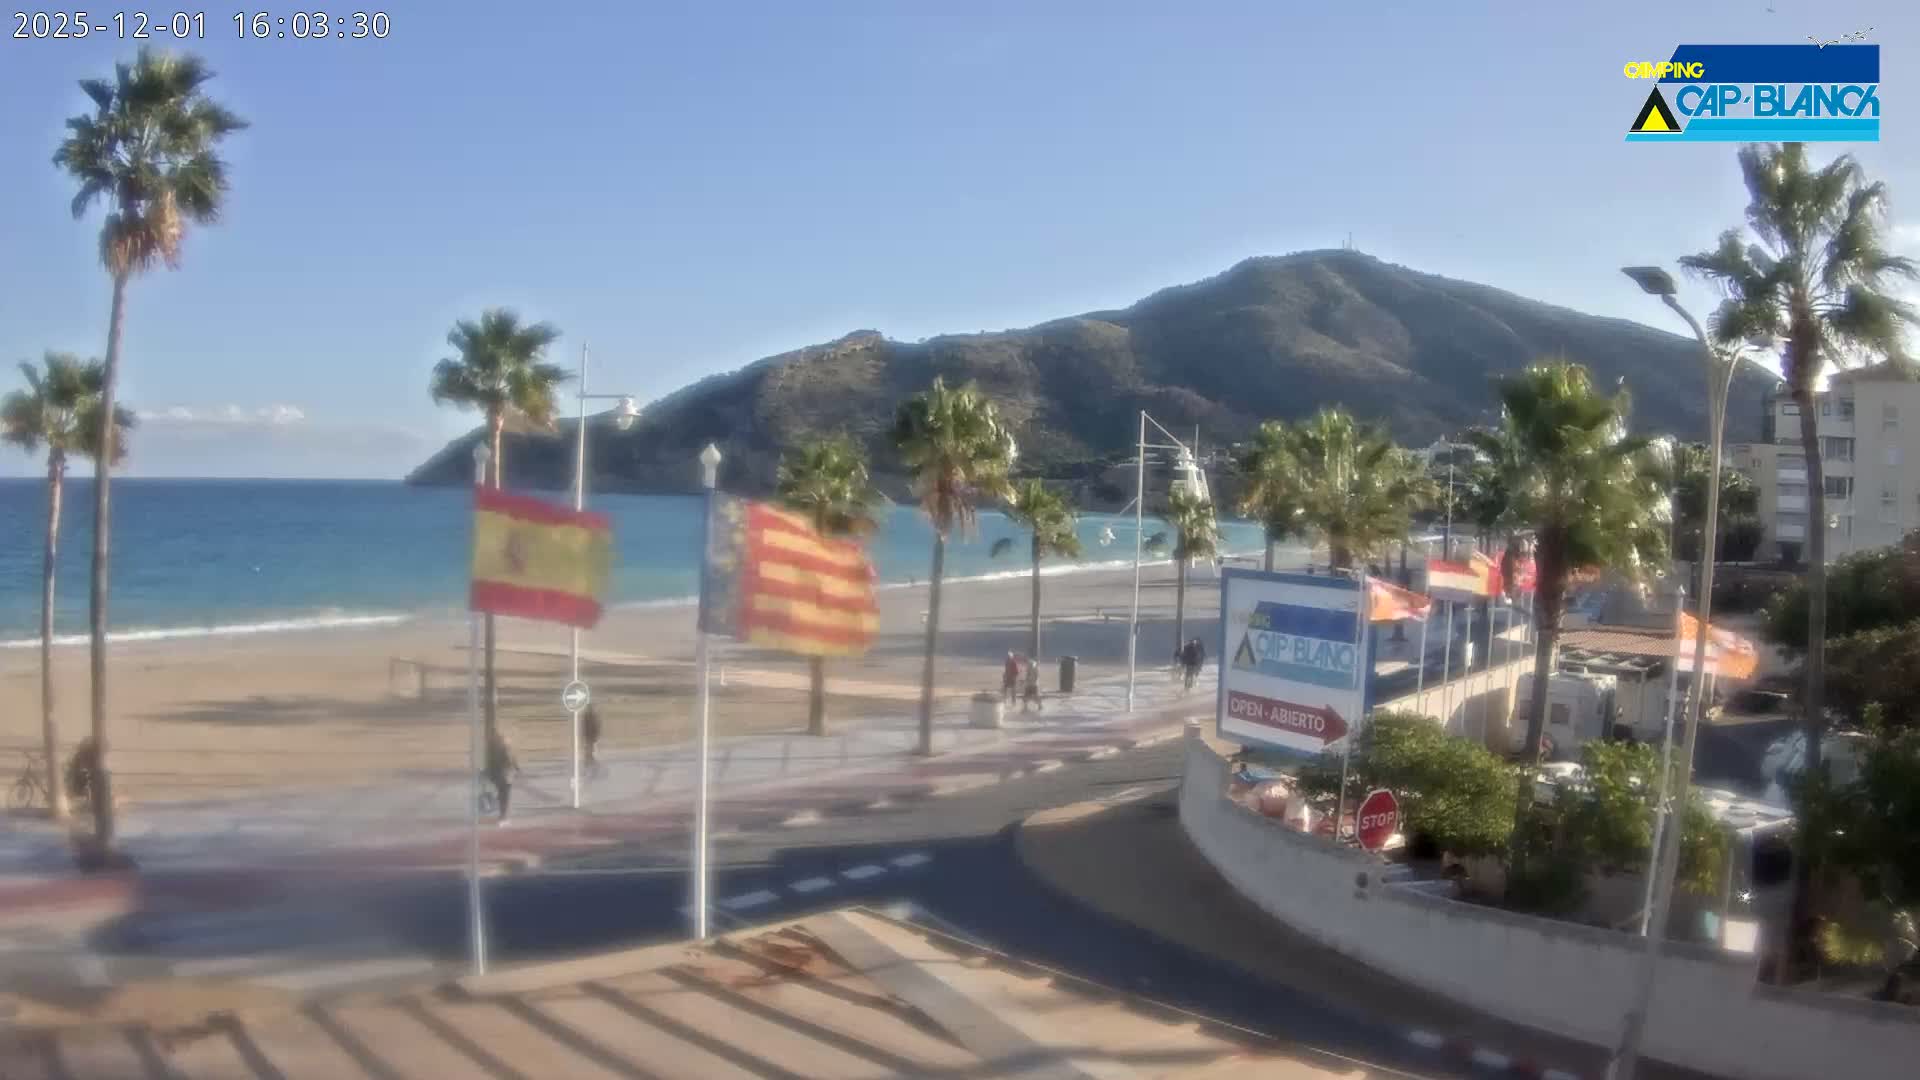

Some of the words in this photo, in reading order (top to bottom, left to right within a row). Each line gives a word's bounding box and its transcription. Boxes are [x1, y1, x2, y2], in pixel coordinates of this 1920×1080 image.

[1231, 697, 1263, 718] OPEN
[1270, 704, 1325, 733] ABIERTO
[1361, 811, 1395, 831] STOP
